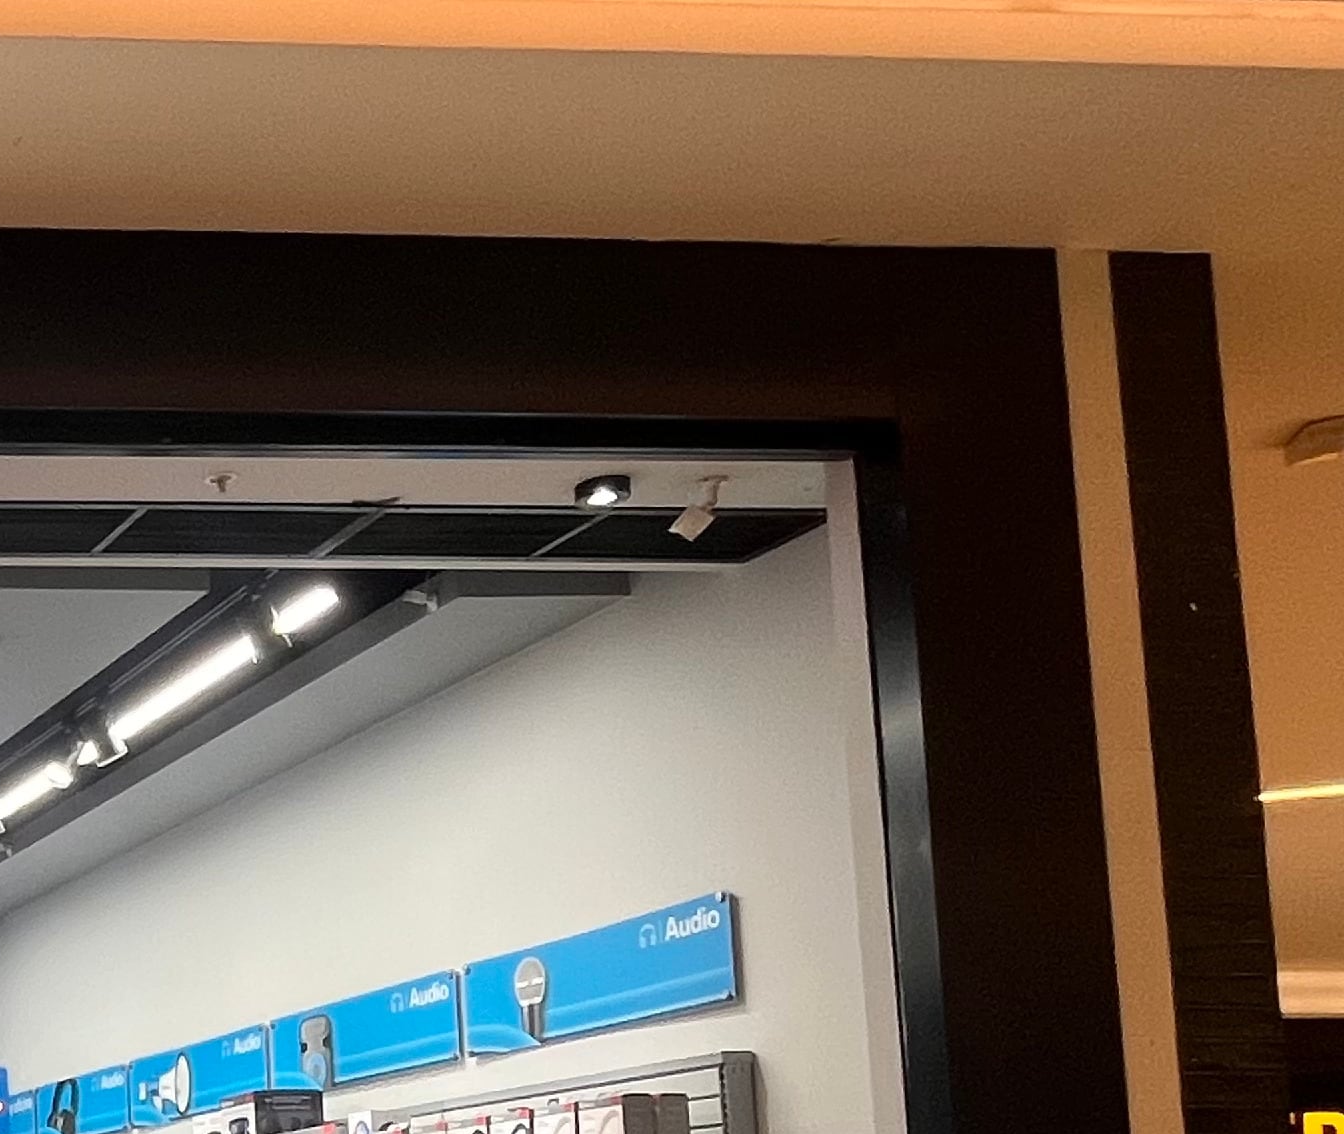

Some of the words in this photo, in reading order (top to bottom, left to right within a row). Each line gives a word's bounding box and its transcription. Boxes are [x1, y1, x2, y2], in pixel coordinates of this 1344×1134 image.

[664, 906, 720, 942] Audio
[408, 981, 450, 1008] Audio
[232, 1034, 262, 1056] Audio
